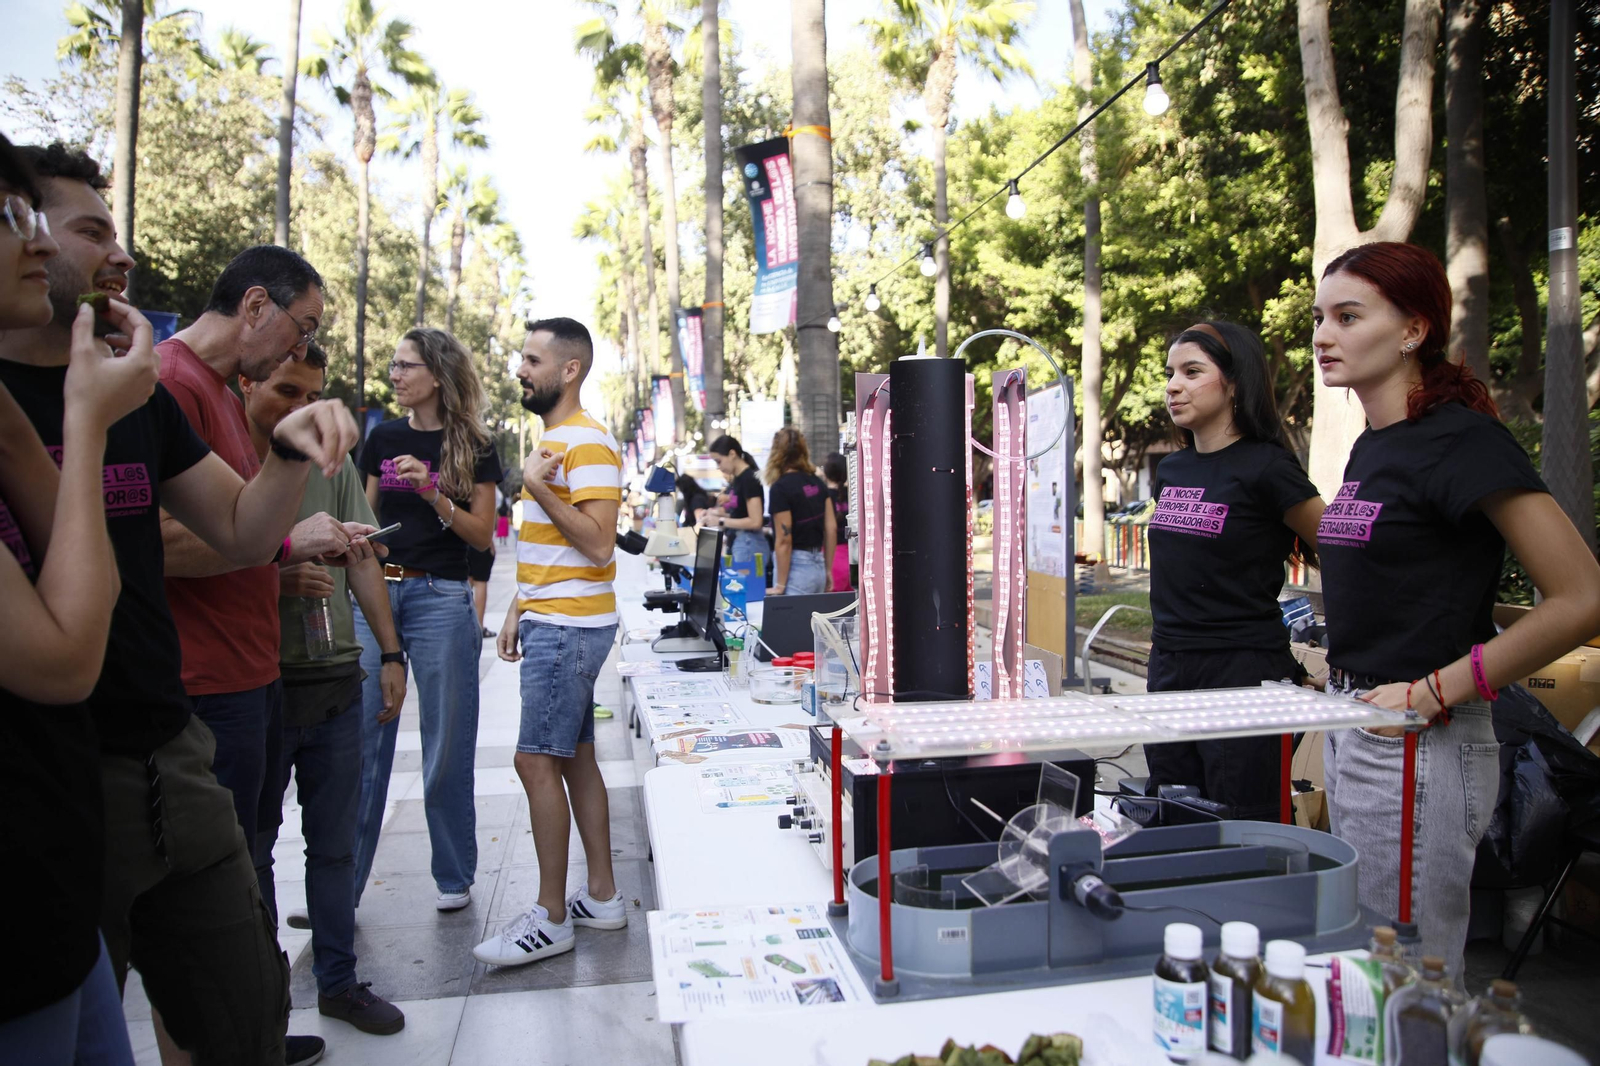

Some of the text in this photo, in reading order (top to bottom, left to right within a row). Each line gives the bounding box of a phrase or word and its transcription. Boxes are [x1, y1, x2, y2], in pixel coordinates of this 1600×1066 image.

[762, 201, 777, 267] LA NOCHE
[113, 466, 145, 482] L@S
[1161, 489, 1201, 499] LA NOCHE
[1338, 485, 1357, 496] OCHE
[1156, 501, 1224, 516] EUROPEA DE L@S
[1344, 503, 1354, 515] DE
[1354, 503, 1376, 517] L@S
